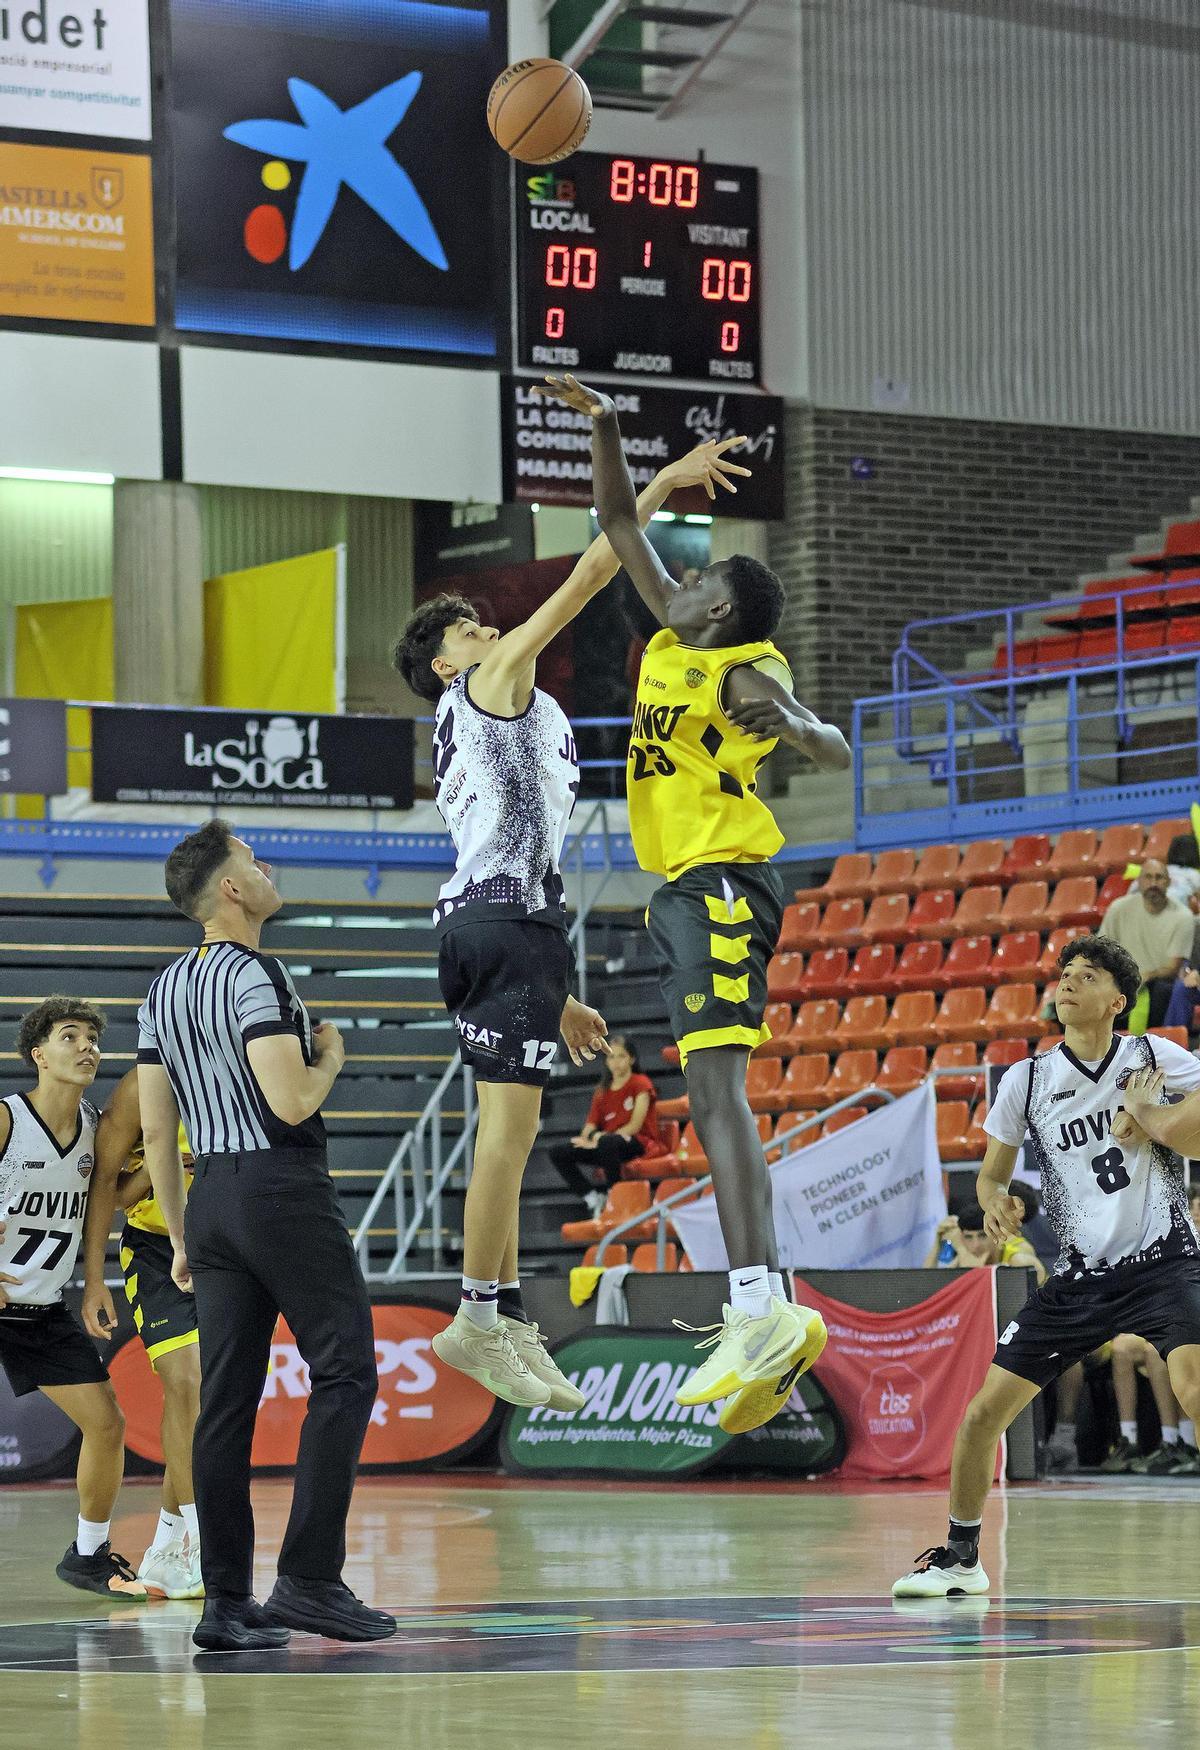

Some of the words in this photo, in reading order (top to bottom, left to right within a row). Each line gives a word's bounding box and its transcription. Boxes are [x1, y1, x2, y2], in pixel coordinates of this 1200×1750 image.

[610, 160, 699, 208] 8:00
[530, 208, 595, 233] LOCAL
[545, 245, 597, 290] 00
[702, 258, 751, 303] 00
[545, 308, 565, 338] 0
[721, 322, 740, 352] 0
[516, 408, 543, 427] LA
[517, 430, 593, 451] COMEN
[212, 739, 328, 790] Soca
[629, 744, 677, 781] 23
[522, 1039, 558, 1070] 12
[801, 1148, 891, 1201] TECHNOLOGY
[1091, 1146, 1131, 1195] 8
[809, 1182, 867, 1217] PIONEER
[817, 1220, 833, 1233] IN
[835, 1195, 878, 1225] CLEAN
[880, 1169, 925, 1202] ENERGY
[10, 1227, 72, 1271] 77
[517, 1426, 563, 1445] Mejores
[638, 1425, 675, 1445] Mejor
